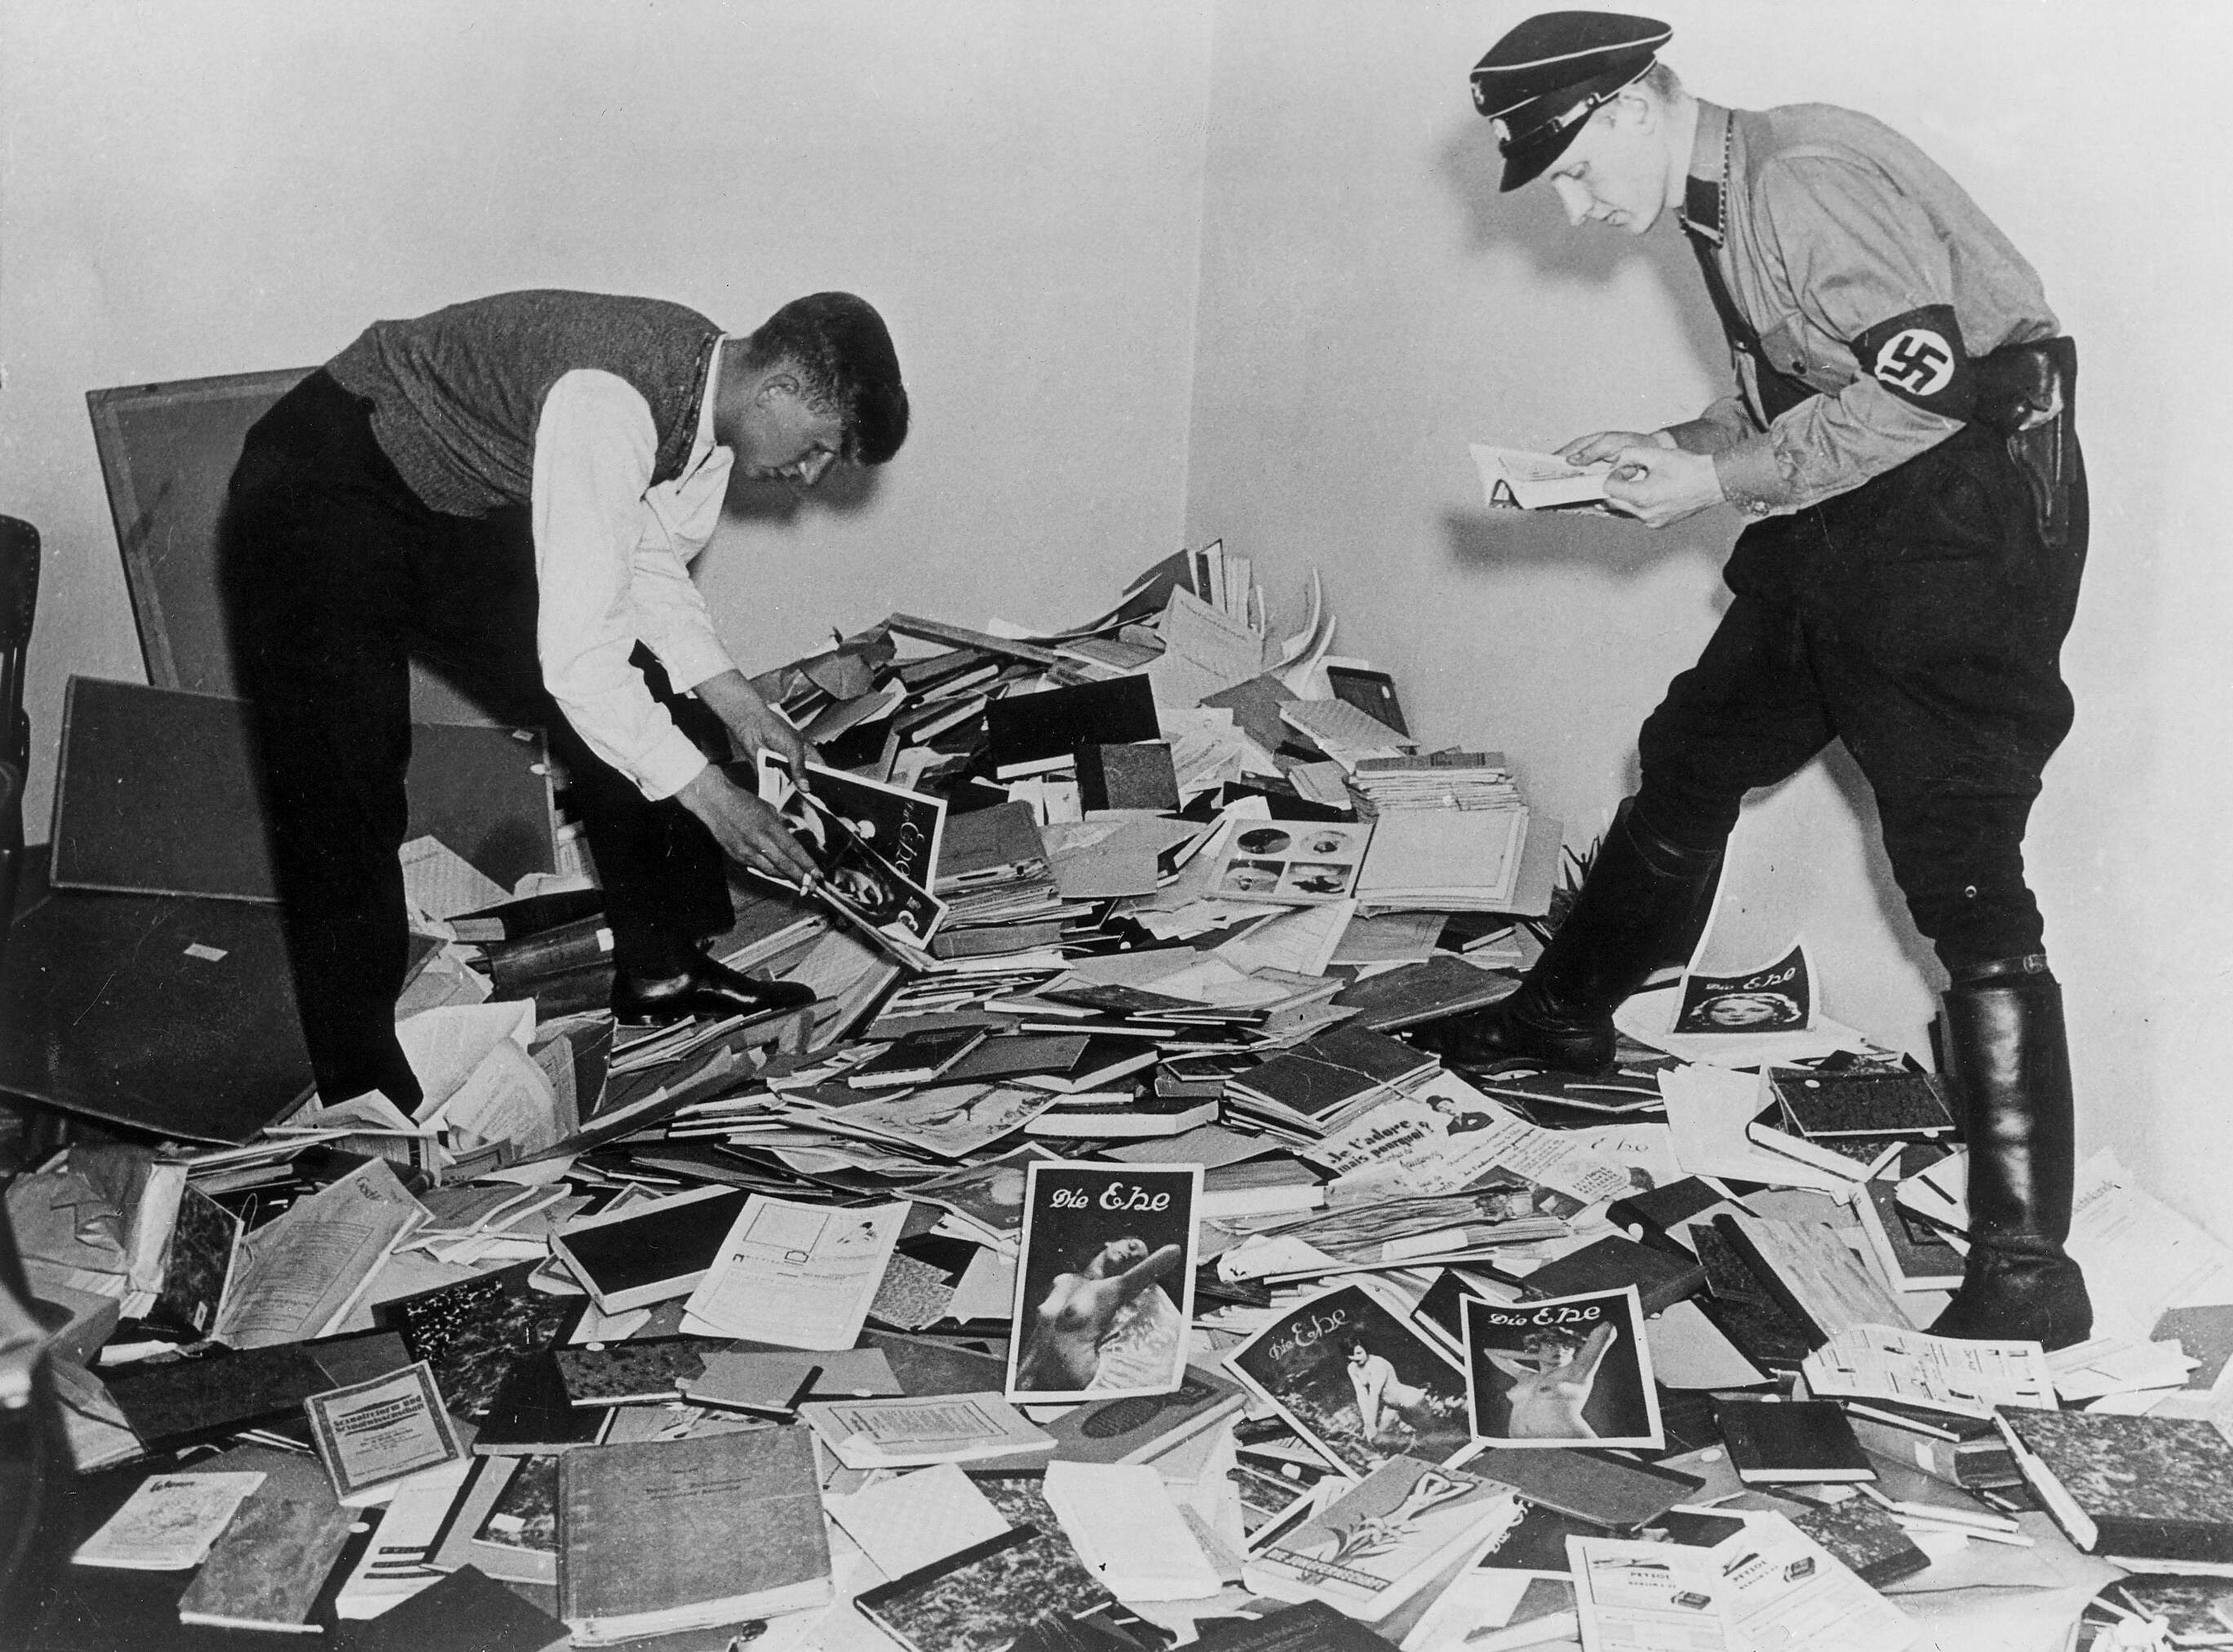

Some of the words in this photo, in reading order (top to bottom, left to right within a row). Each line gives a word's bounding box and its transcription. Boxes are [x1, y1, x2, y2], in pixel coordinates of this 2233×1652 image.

[894, 822, 926, 877] Ehe
[1742, 967, 1796, 990] Ehe
[1327, 1151, 1351, 1163] Je
[1348, 1120, 1411, 1149] t'adore
[1337, 1155, 1370, 1173] mais
[1370, 1128, 1425, 1158] pourquoi
[1418, 1121, 1434, 1133] ?
[1049, 1187, 1089, 1209] Die
[1099, 1181, 1171, 1211] Ehe
[1269, 1338, 1294, 1361] Die
[1291, 1309, 1352, 1347] Ehe
[1488, 1313, 1528, 1326] Die
[1532, 1306, 1602, 1326] Ehe
